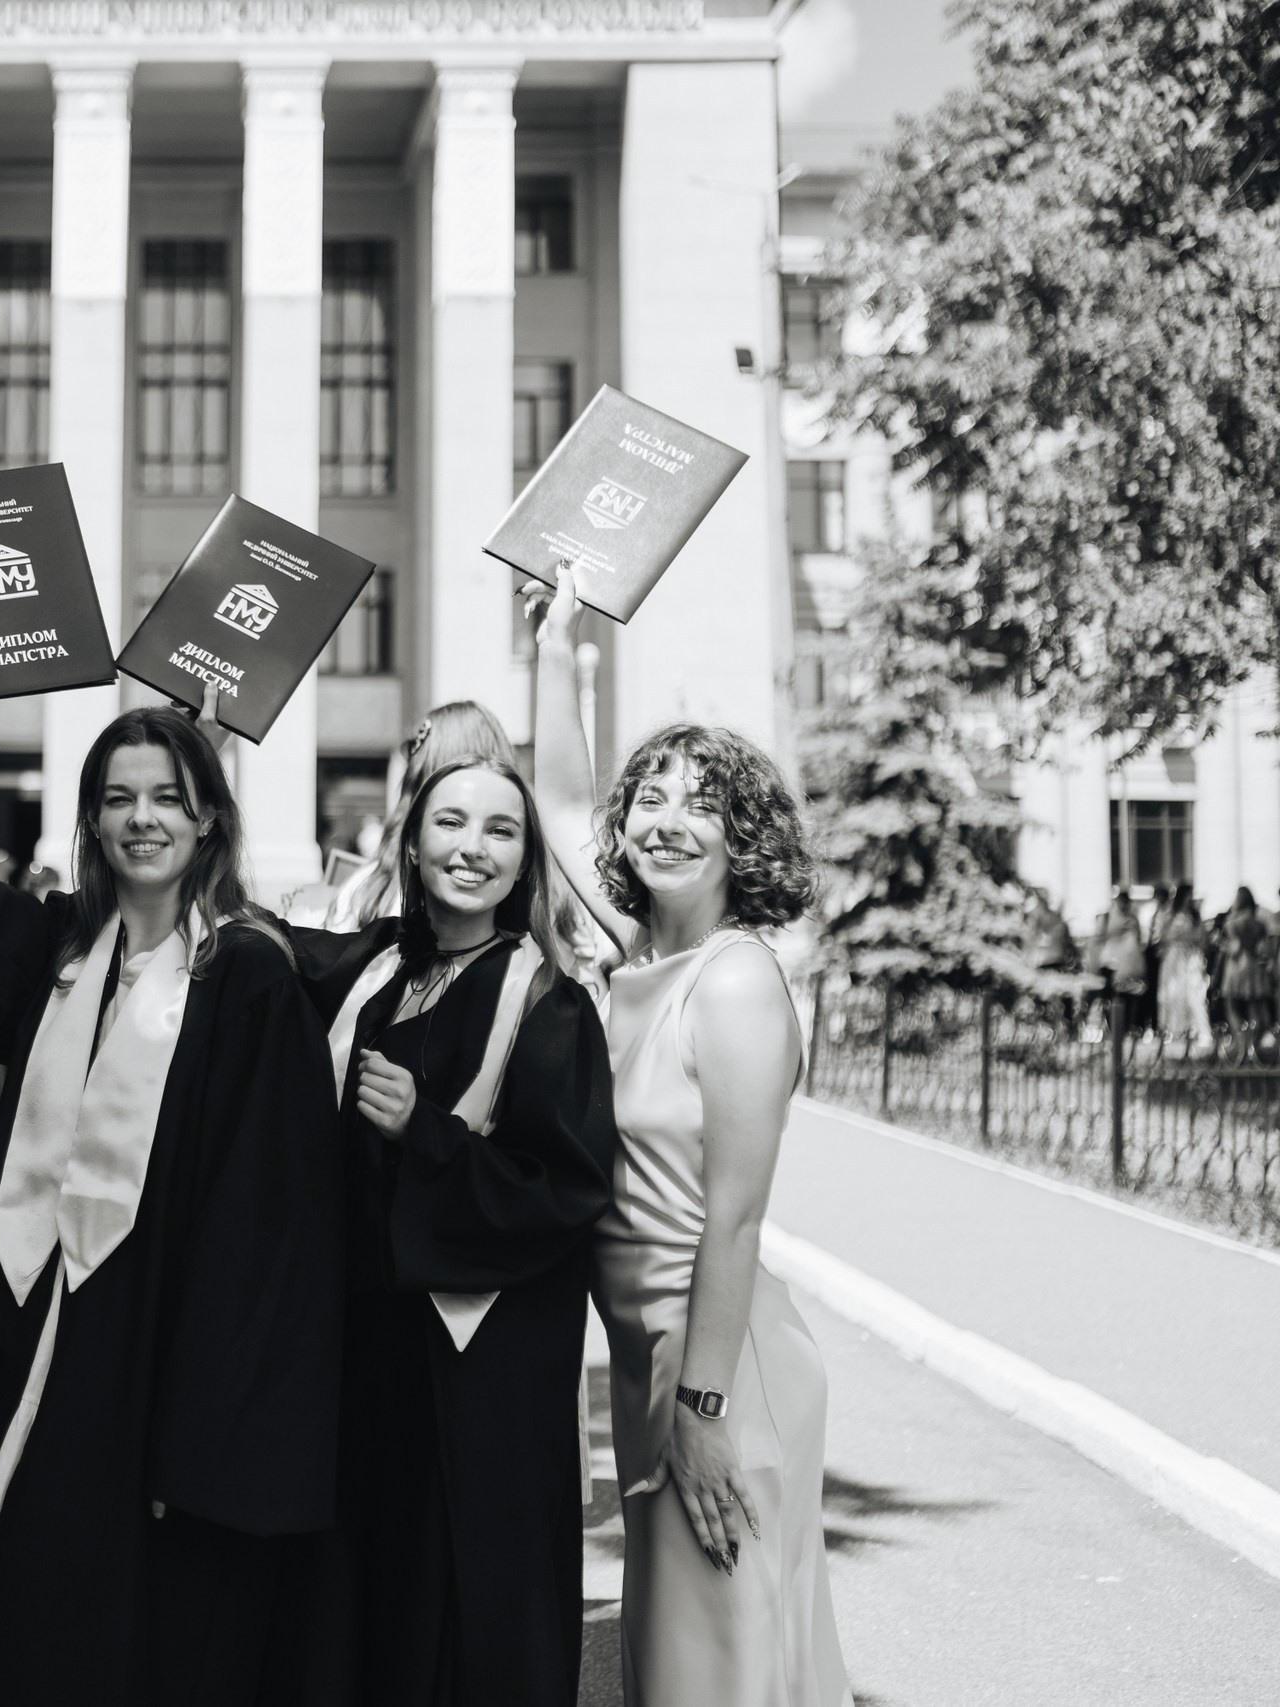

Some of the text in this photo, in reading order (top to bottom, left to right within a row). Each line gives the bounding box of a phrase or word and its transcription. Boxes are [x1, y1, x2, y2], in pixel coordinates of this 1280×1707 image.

[618, 437, 685, 475] ДИПЛОМ
[624, 422, 695, 467] МАГІСТРА
[168, 652, 238, 698] МАГІСТРА
[178, 641, 246, 681] ДИПЛОМ
